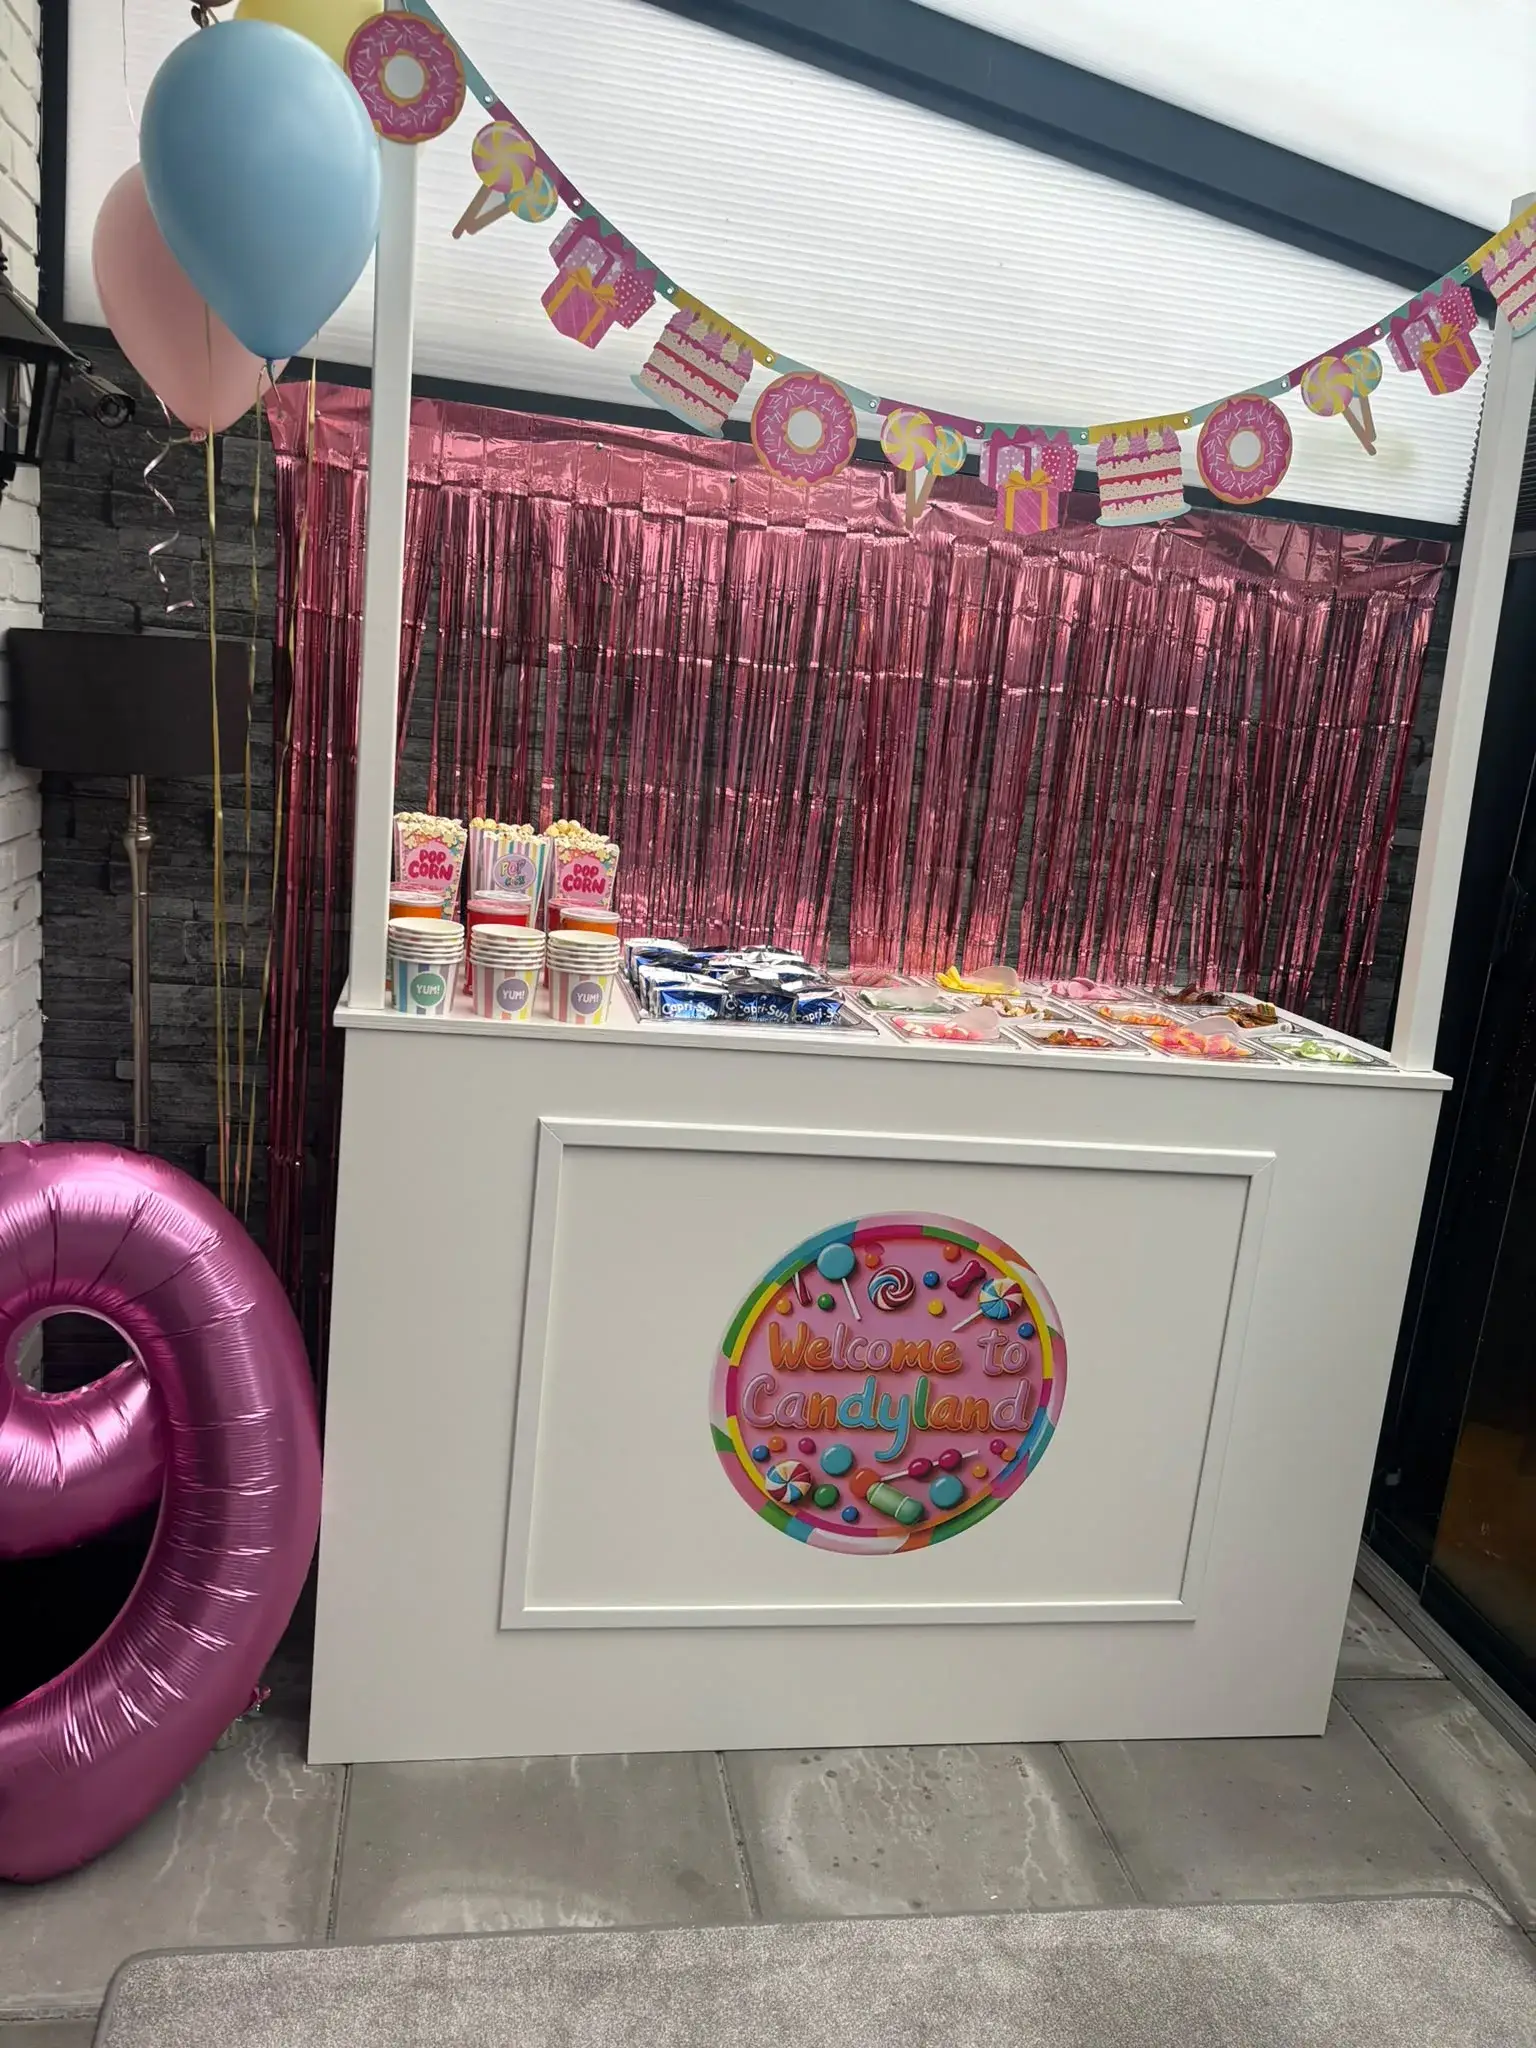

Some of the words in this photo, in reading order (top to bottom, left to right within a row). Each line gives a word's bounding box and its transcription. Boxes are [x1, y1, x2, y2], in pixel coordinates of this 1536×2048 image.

[419, 849, 447, 864] POP
[407, 861, 453, 881] CORN
[500, 859, 526, 877] POP
[573, 863, 599, 878] POP
[562, 876, 606, 894] CORN
[416, 984, 441, 995] YUM!
[502, 989, 526, 1001] YUM!
[577, 993, 600, 1004] YUM!
[661, 1000, 718, 1017] Capri-Sun
[768, 1321, 962, 1372] Welcome
[978, 1328, 1029, 1376] to
[741, 1373, 1032, 1462] Candyland
